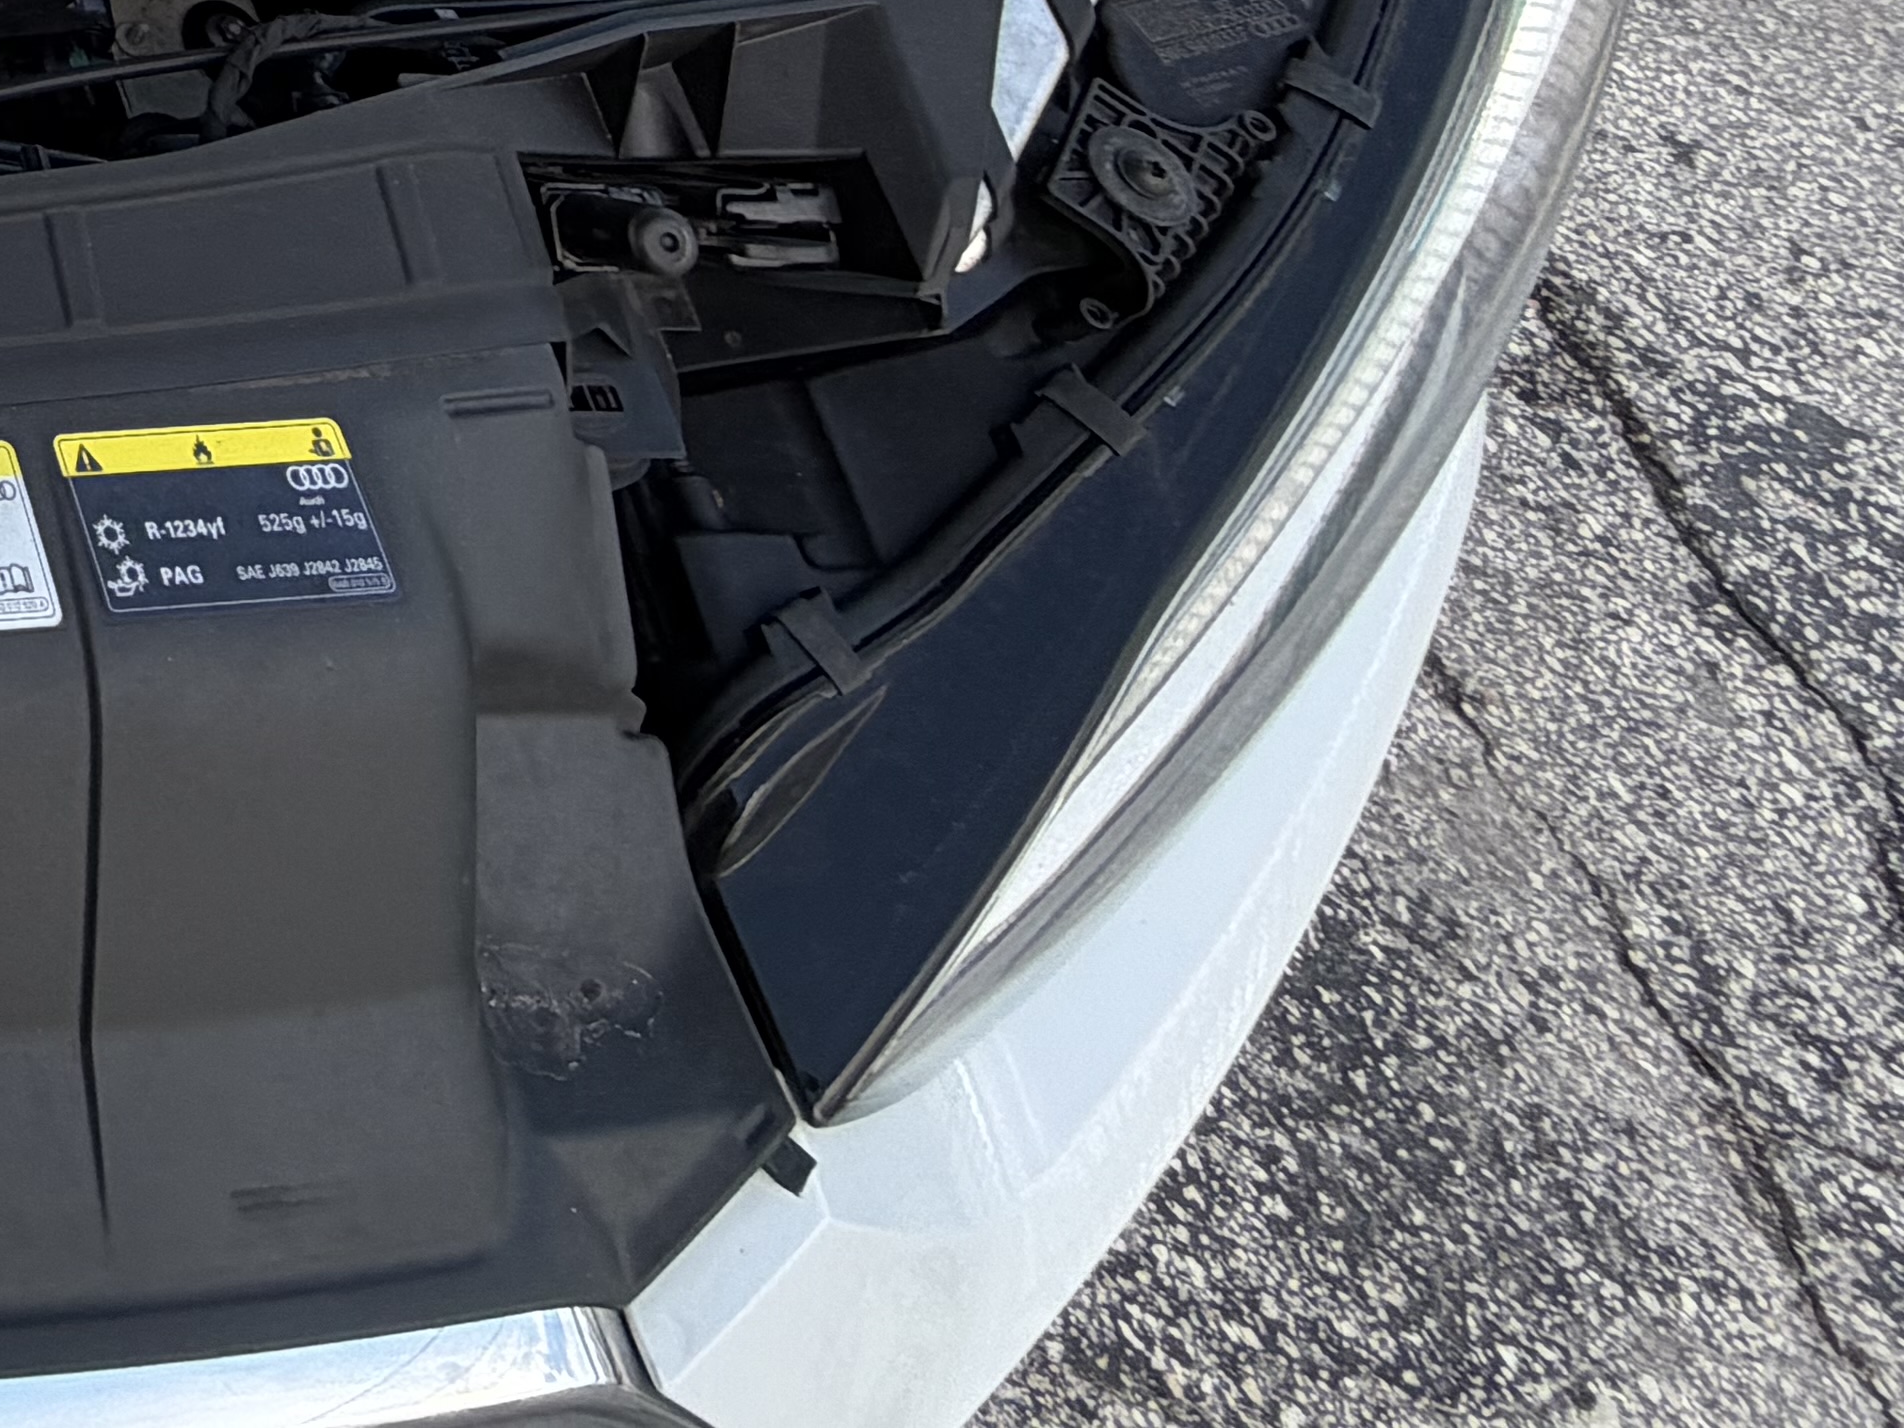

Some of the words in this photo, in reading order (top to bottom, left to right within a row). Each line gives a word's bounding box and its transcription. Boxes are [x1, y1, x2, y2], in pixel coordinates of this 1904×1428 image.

[144, 516, 226, 541] R-1234yf
[258, 513, 306, 535] 525g
[310, 508, 368, 530] +/-15g
[160, 564, 204, 586] PAG
[236, 563, 265, 580] SAE
[269, 561, 300, 578] J639
[303, 559, 342, 576] J2842
[344, 556, 383, 573] J2845
